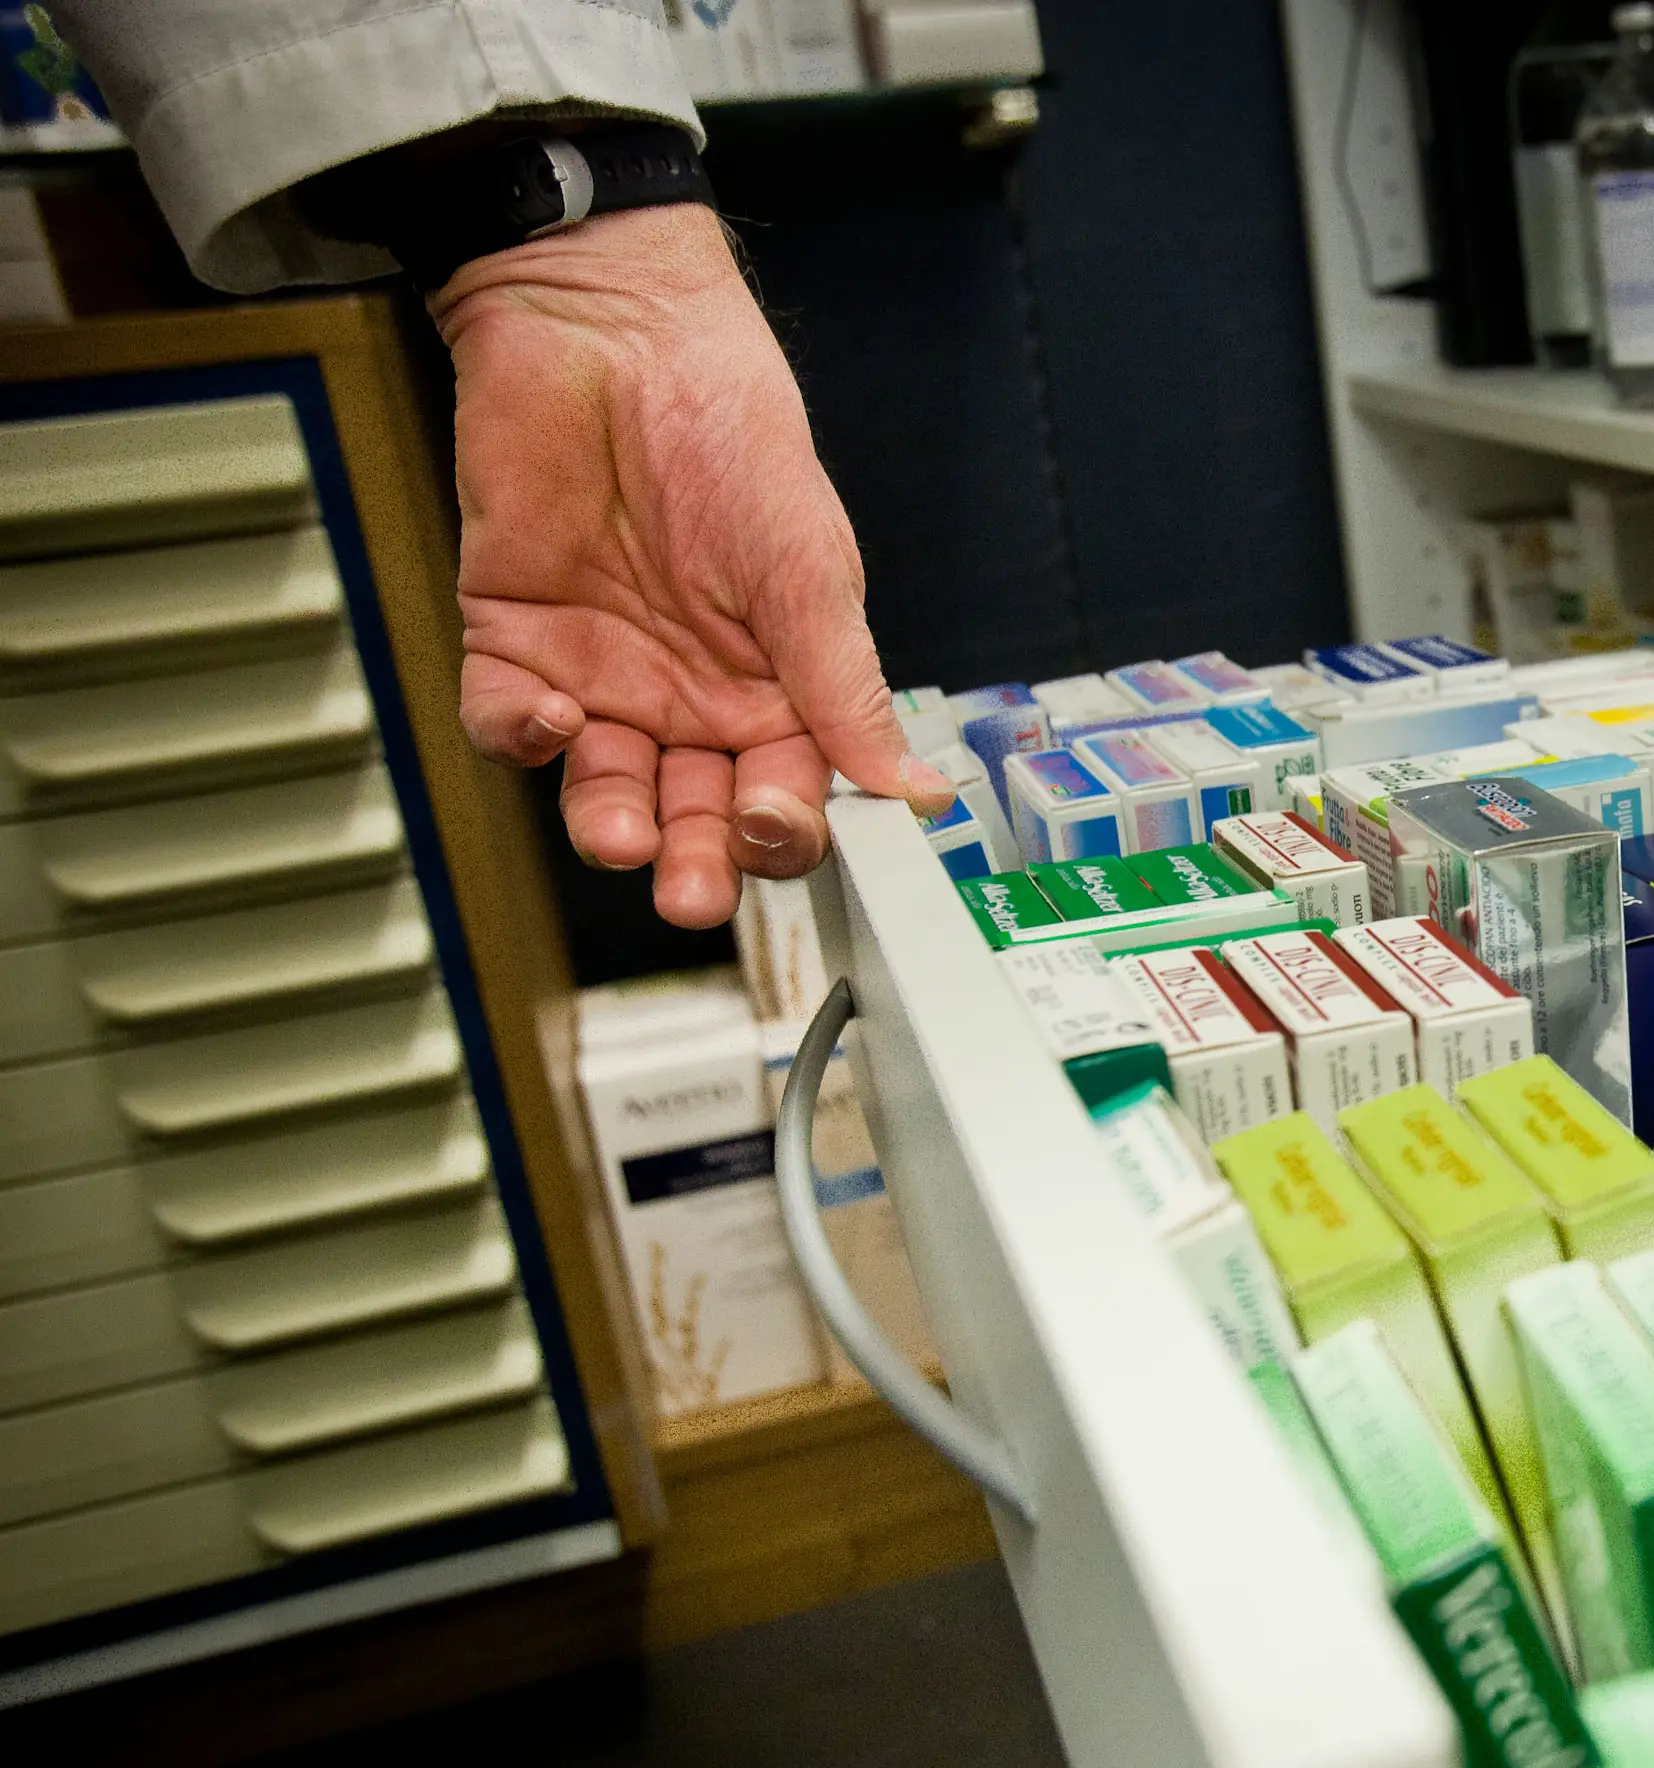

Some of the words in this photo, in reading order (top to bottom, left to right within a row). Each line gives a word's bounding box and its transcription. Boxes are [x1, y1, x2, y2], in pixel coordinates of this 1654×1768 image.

[1529, 863, 1540, 901] sollievo
[1496, 902, 1508, 944] pazienti
[1483, 926, 1496, 969] SCOPAN
[1532, 922, 1545, 988] consentendo
